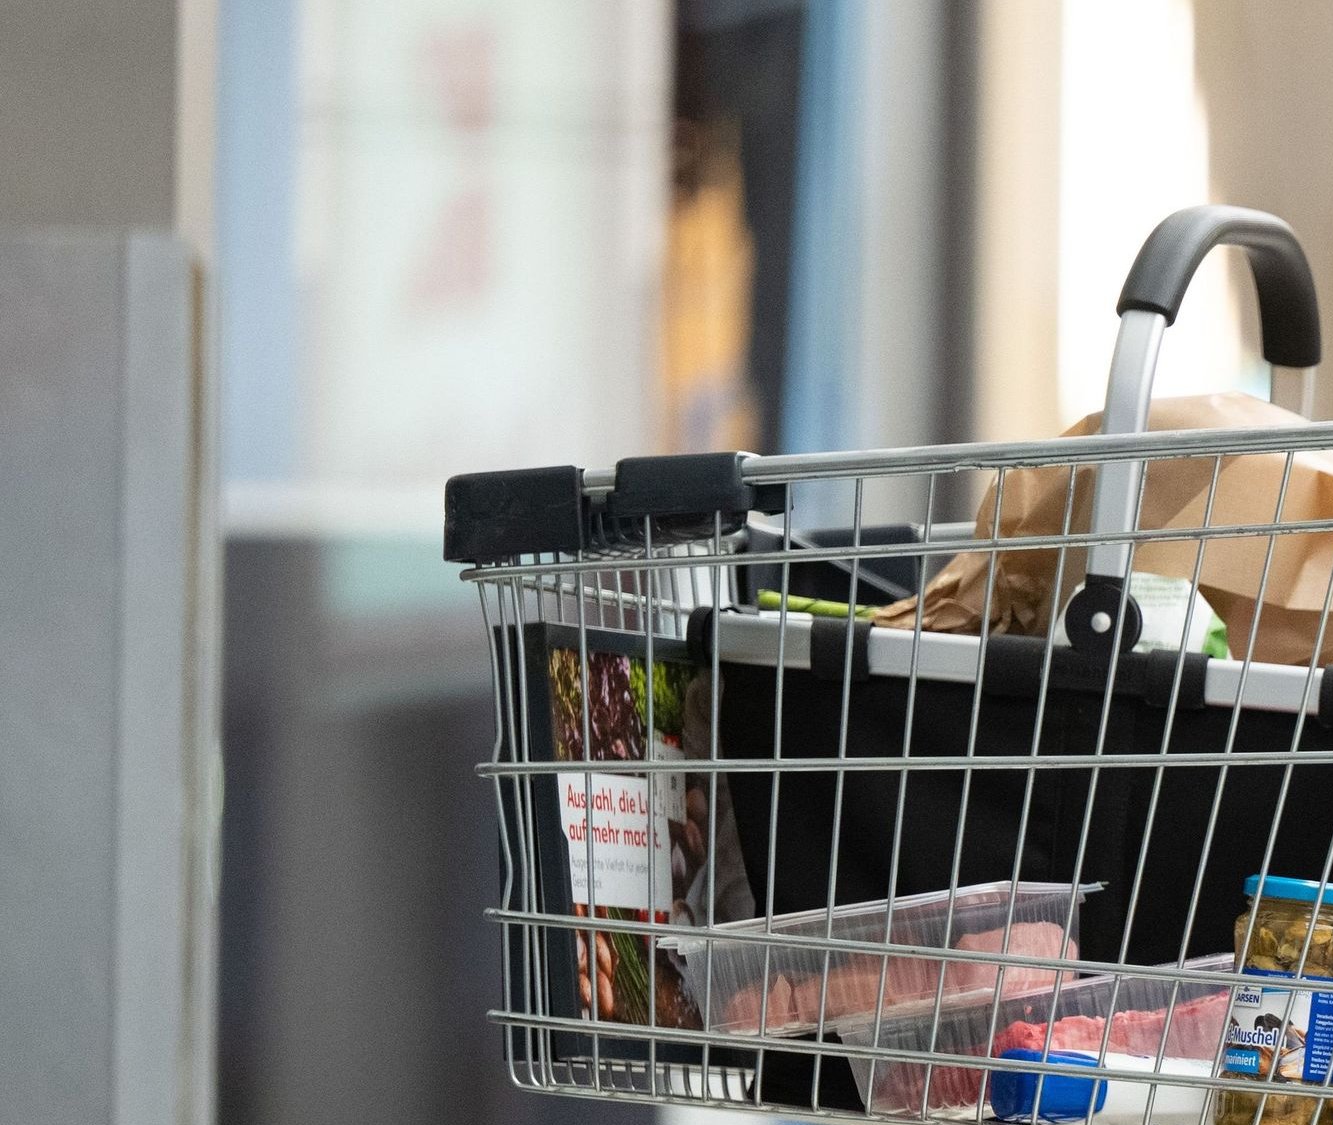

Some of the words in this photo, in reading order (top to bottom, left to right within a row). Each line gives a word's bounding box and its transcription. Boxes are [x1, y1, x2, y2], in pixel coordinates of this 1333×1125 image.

[619, 790, 635, 814] die
[592, 822, 620, 845] mehr
[624, 824, 661, 849] mact.
[1236, 993, 1260, 1003] ARSEN
